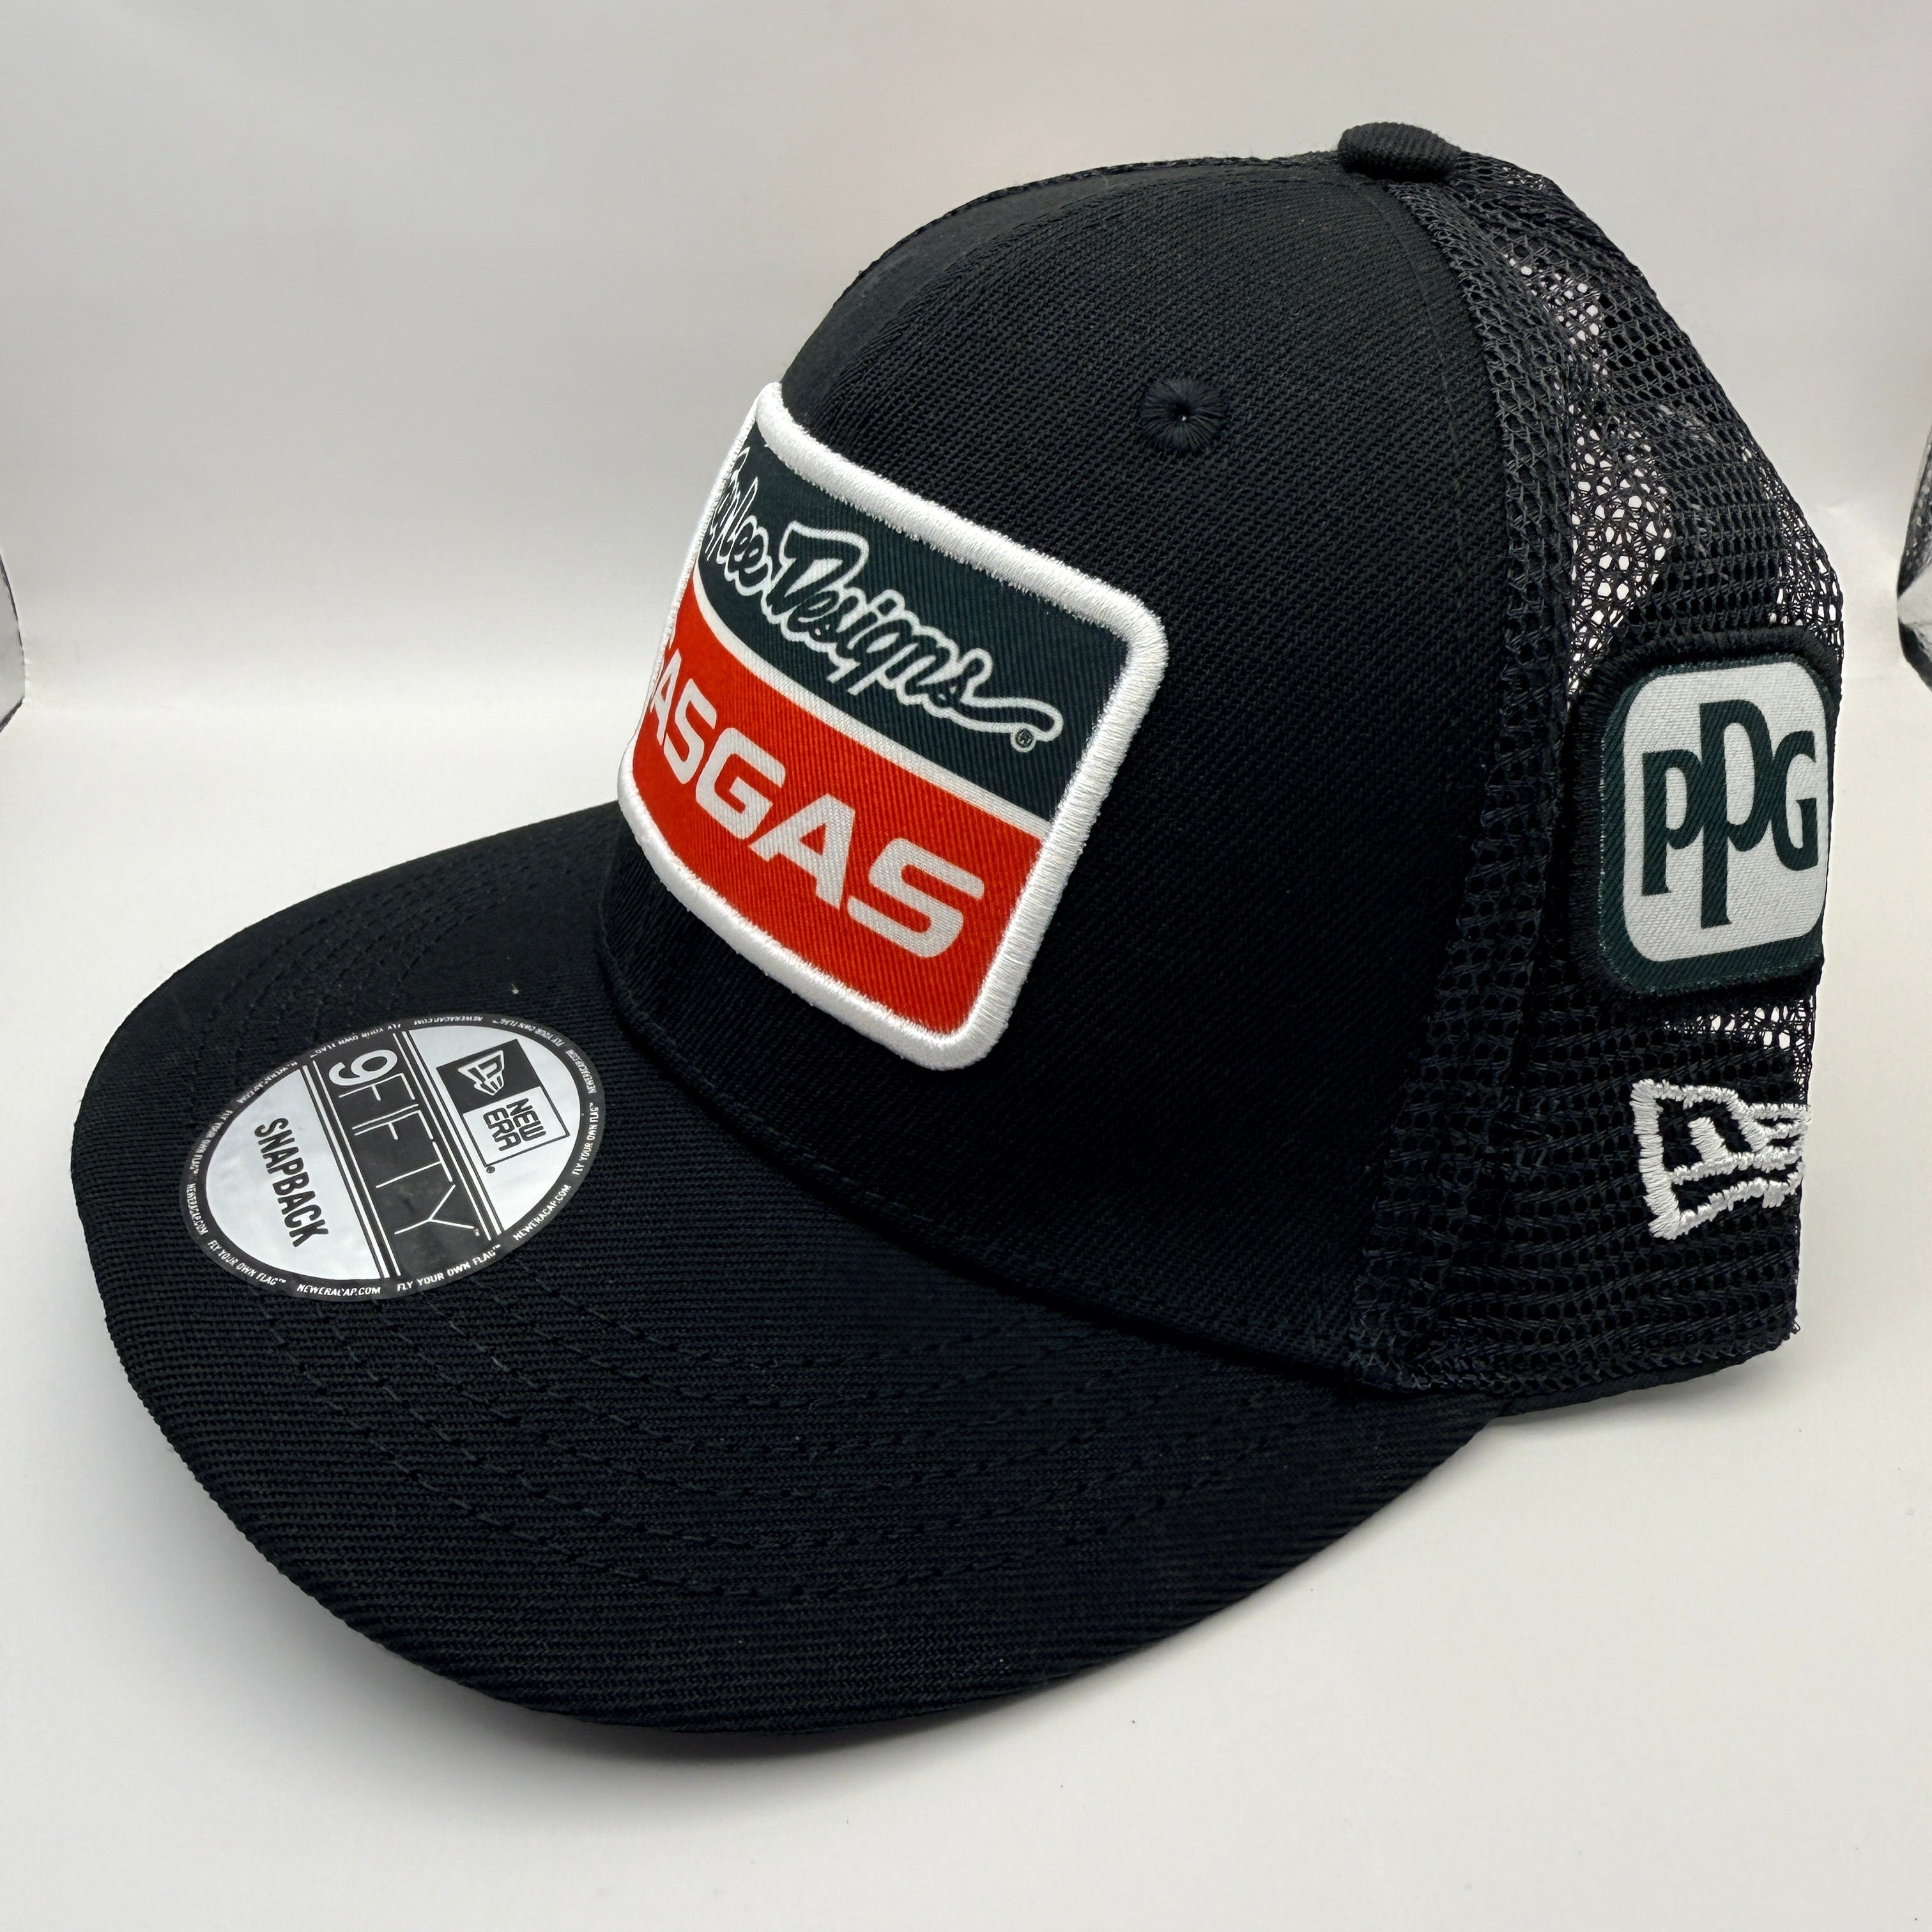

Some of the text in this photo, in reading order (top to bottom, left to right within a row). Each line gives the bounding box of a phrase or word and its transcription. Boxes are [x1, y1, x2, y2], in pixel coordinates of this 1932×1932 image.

[760, 520, 1064, 742] Designs
[650, 645, 984, 958] ASGAS
[1641, 698, 1820, 930] PPG
[254, 1117, 329, 1248] SNAPBACK
[329, 1049, 475, 1235] 9FIFTY
[483, 1107, 521, 1151] ERA
[506, 1098, 546, 1142] NEW
[208, 1240, 222, 1251] FLY
[218, 1249, 239, 1267] YOUR
[236, 1262, 257, 1276] OWN
[397, 1281, 413, 1291] FLY
[417, 1273, 445, 1286] YOUR
[447, 1261, 470, 1276] OWN
